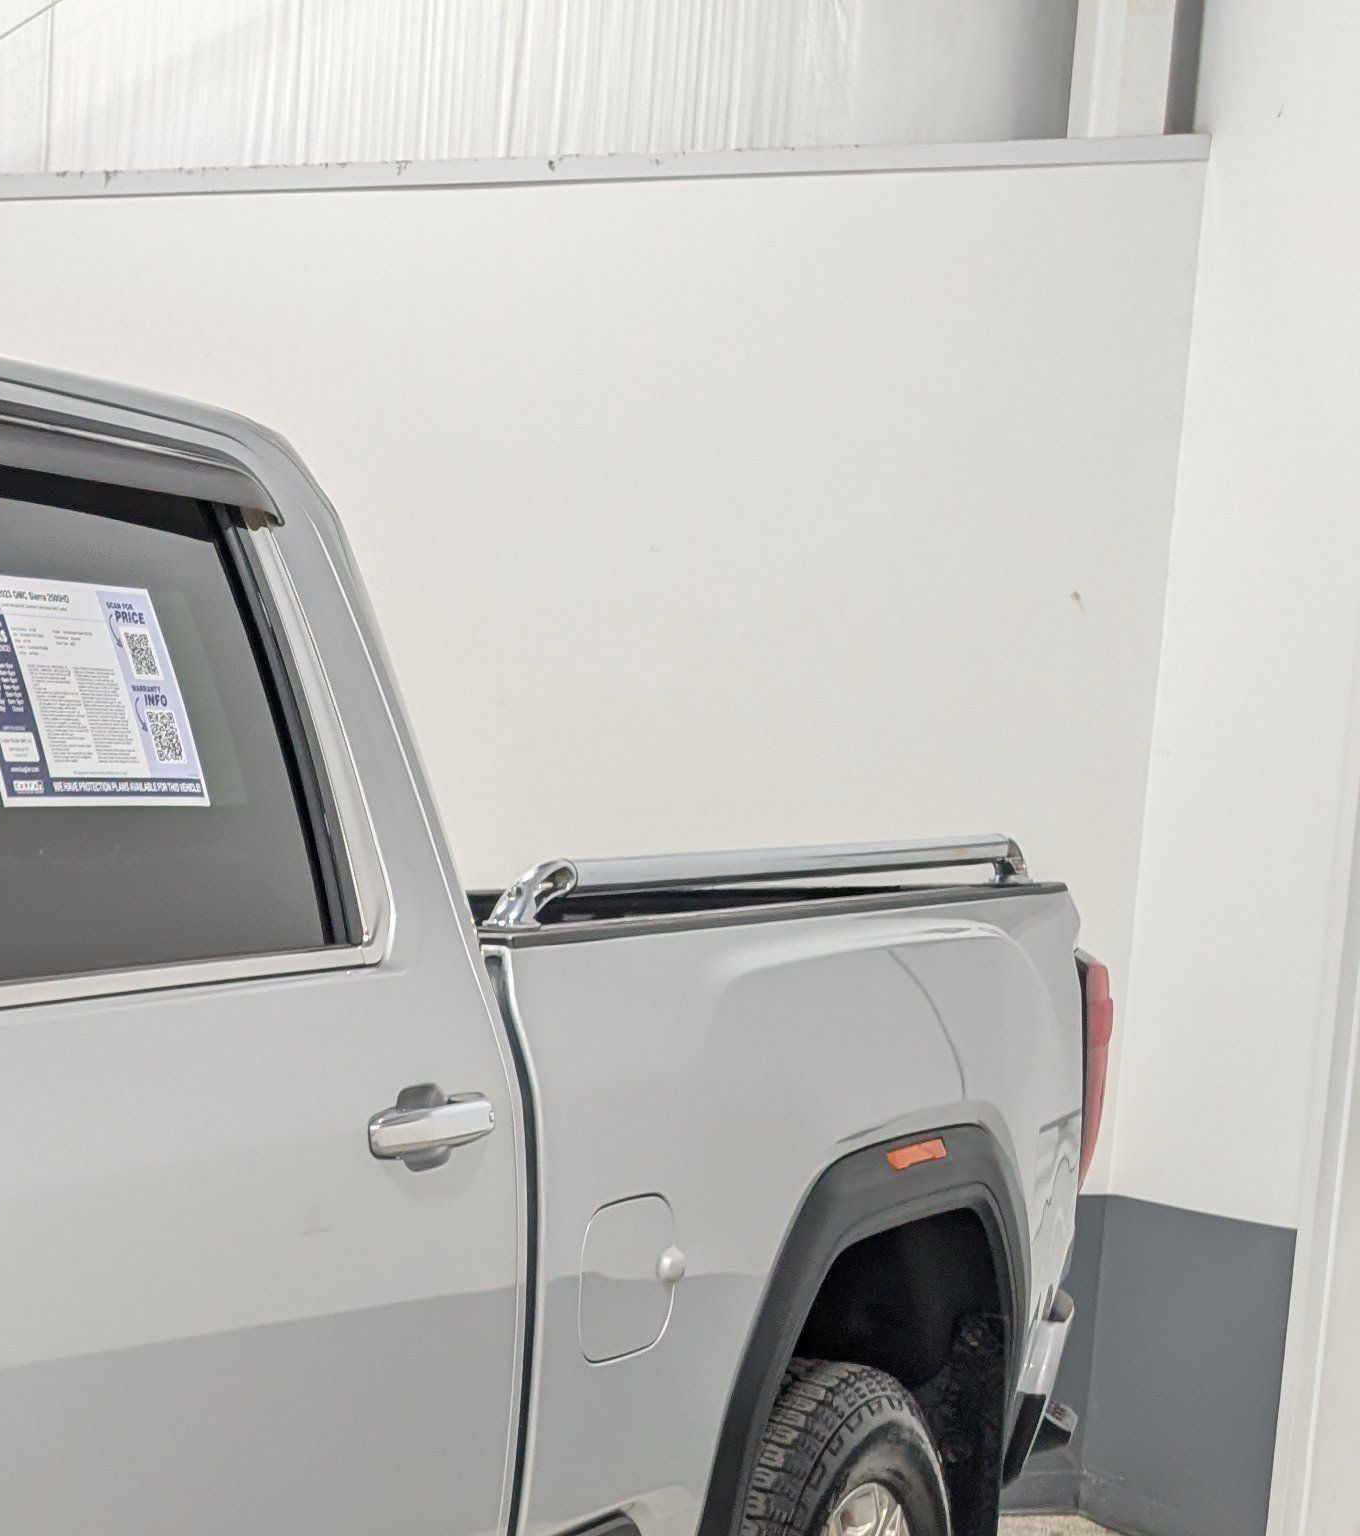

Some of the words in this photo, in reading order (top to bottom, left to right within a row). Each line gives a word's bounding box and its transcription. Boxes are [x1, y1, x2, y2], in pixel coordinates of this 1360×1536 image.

[12, 590, 28, 600] GMC
[28, 591, 47, 601] Sierra
[46, 593, 70, 603] 2500HD
[105, 601, 122, 609] SCAN
[114, 611, 147, 625] PRICE
[130, 684, 162, 693] WARRANTY
[145, 694, 168, 707] INFO
[78, 782, 113, 791] PROTECTION
[111, 782, 130, 791] PLANS
[129, 783, 158, 791] AVAILABLE
